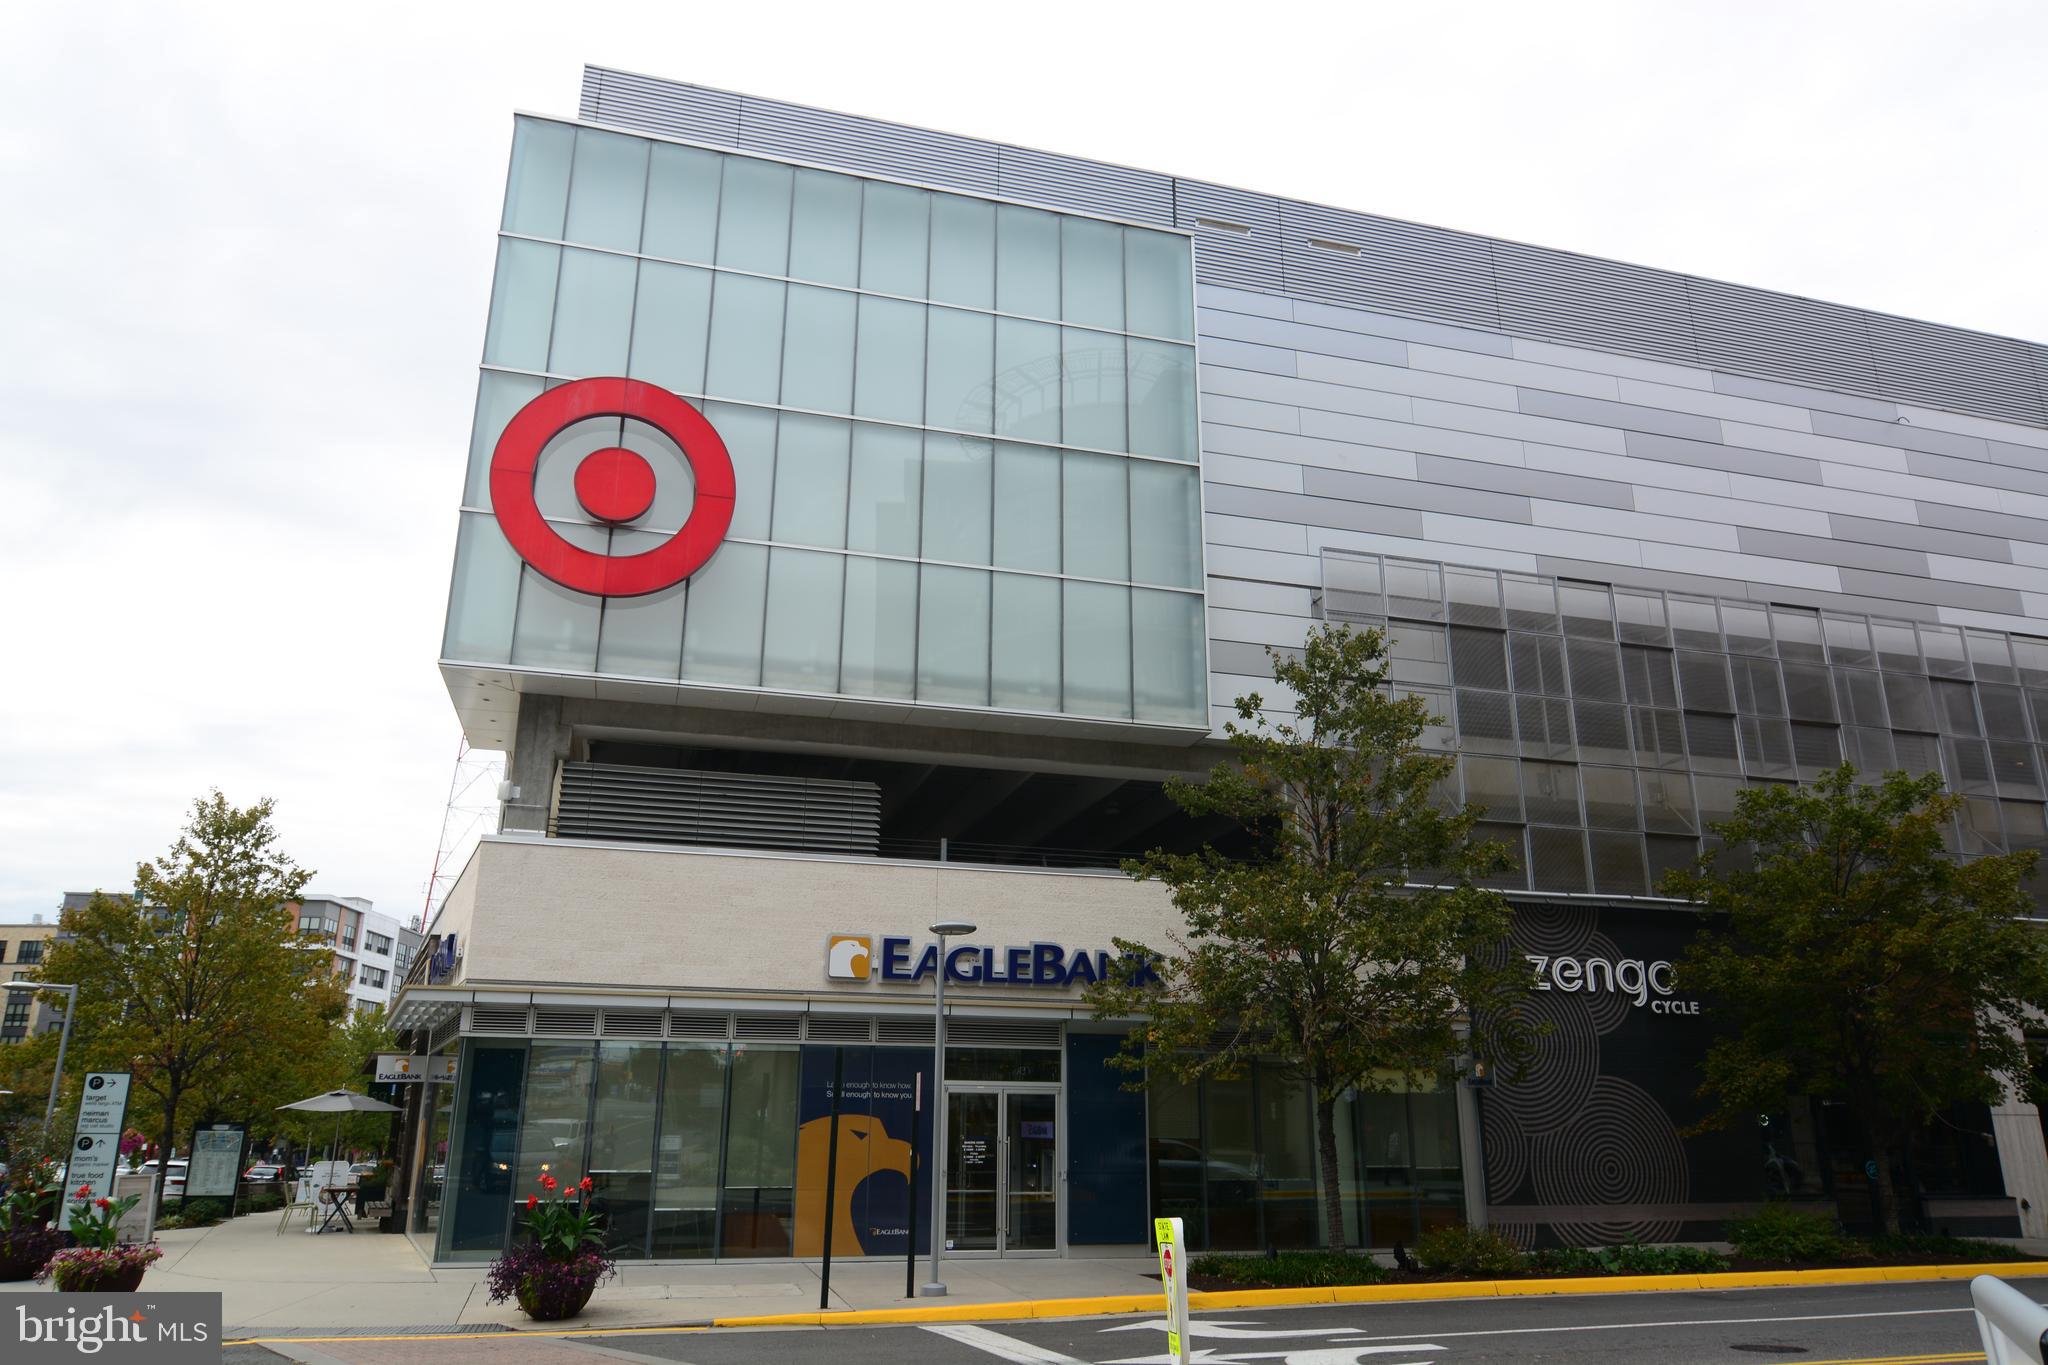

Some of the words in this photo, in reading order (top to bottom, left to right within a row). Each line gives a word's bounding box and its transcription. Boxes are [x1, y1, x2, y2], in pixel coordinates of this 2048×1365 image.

[1525, 955, 1679, 1007] zengo
[1651, 1000, 1700, 1015] CYCLE
[846, 1081, 870, 1090] enough
[880, 1081, 896, 1089] know
[846, 1090, 871, 1099] enough
[881, 1091, 899, 1099] know
[876, 1228, 909, 1236] EAGLEBAN
